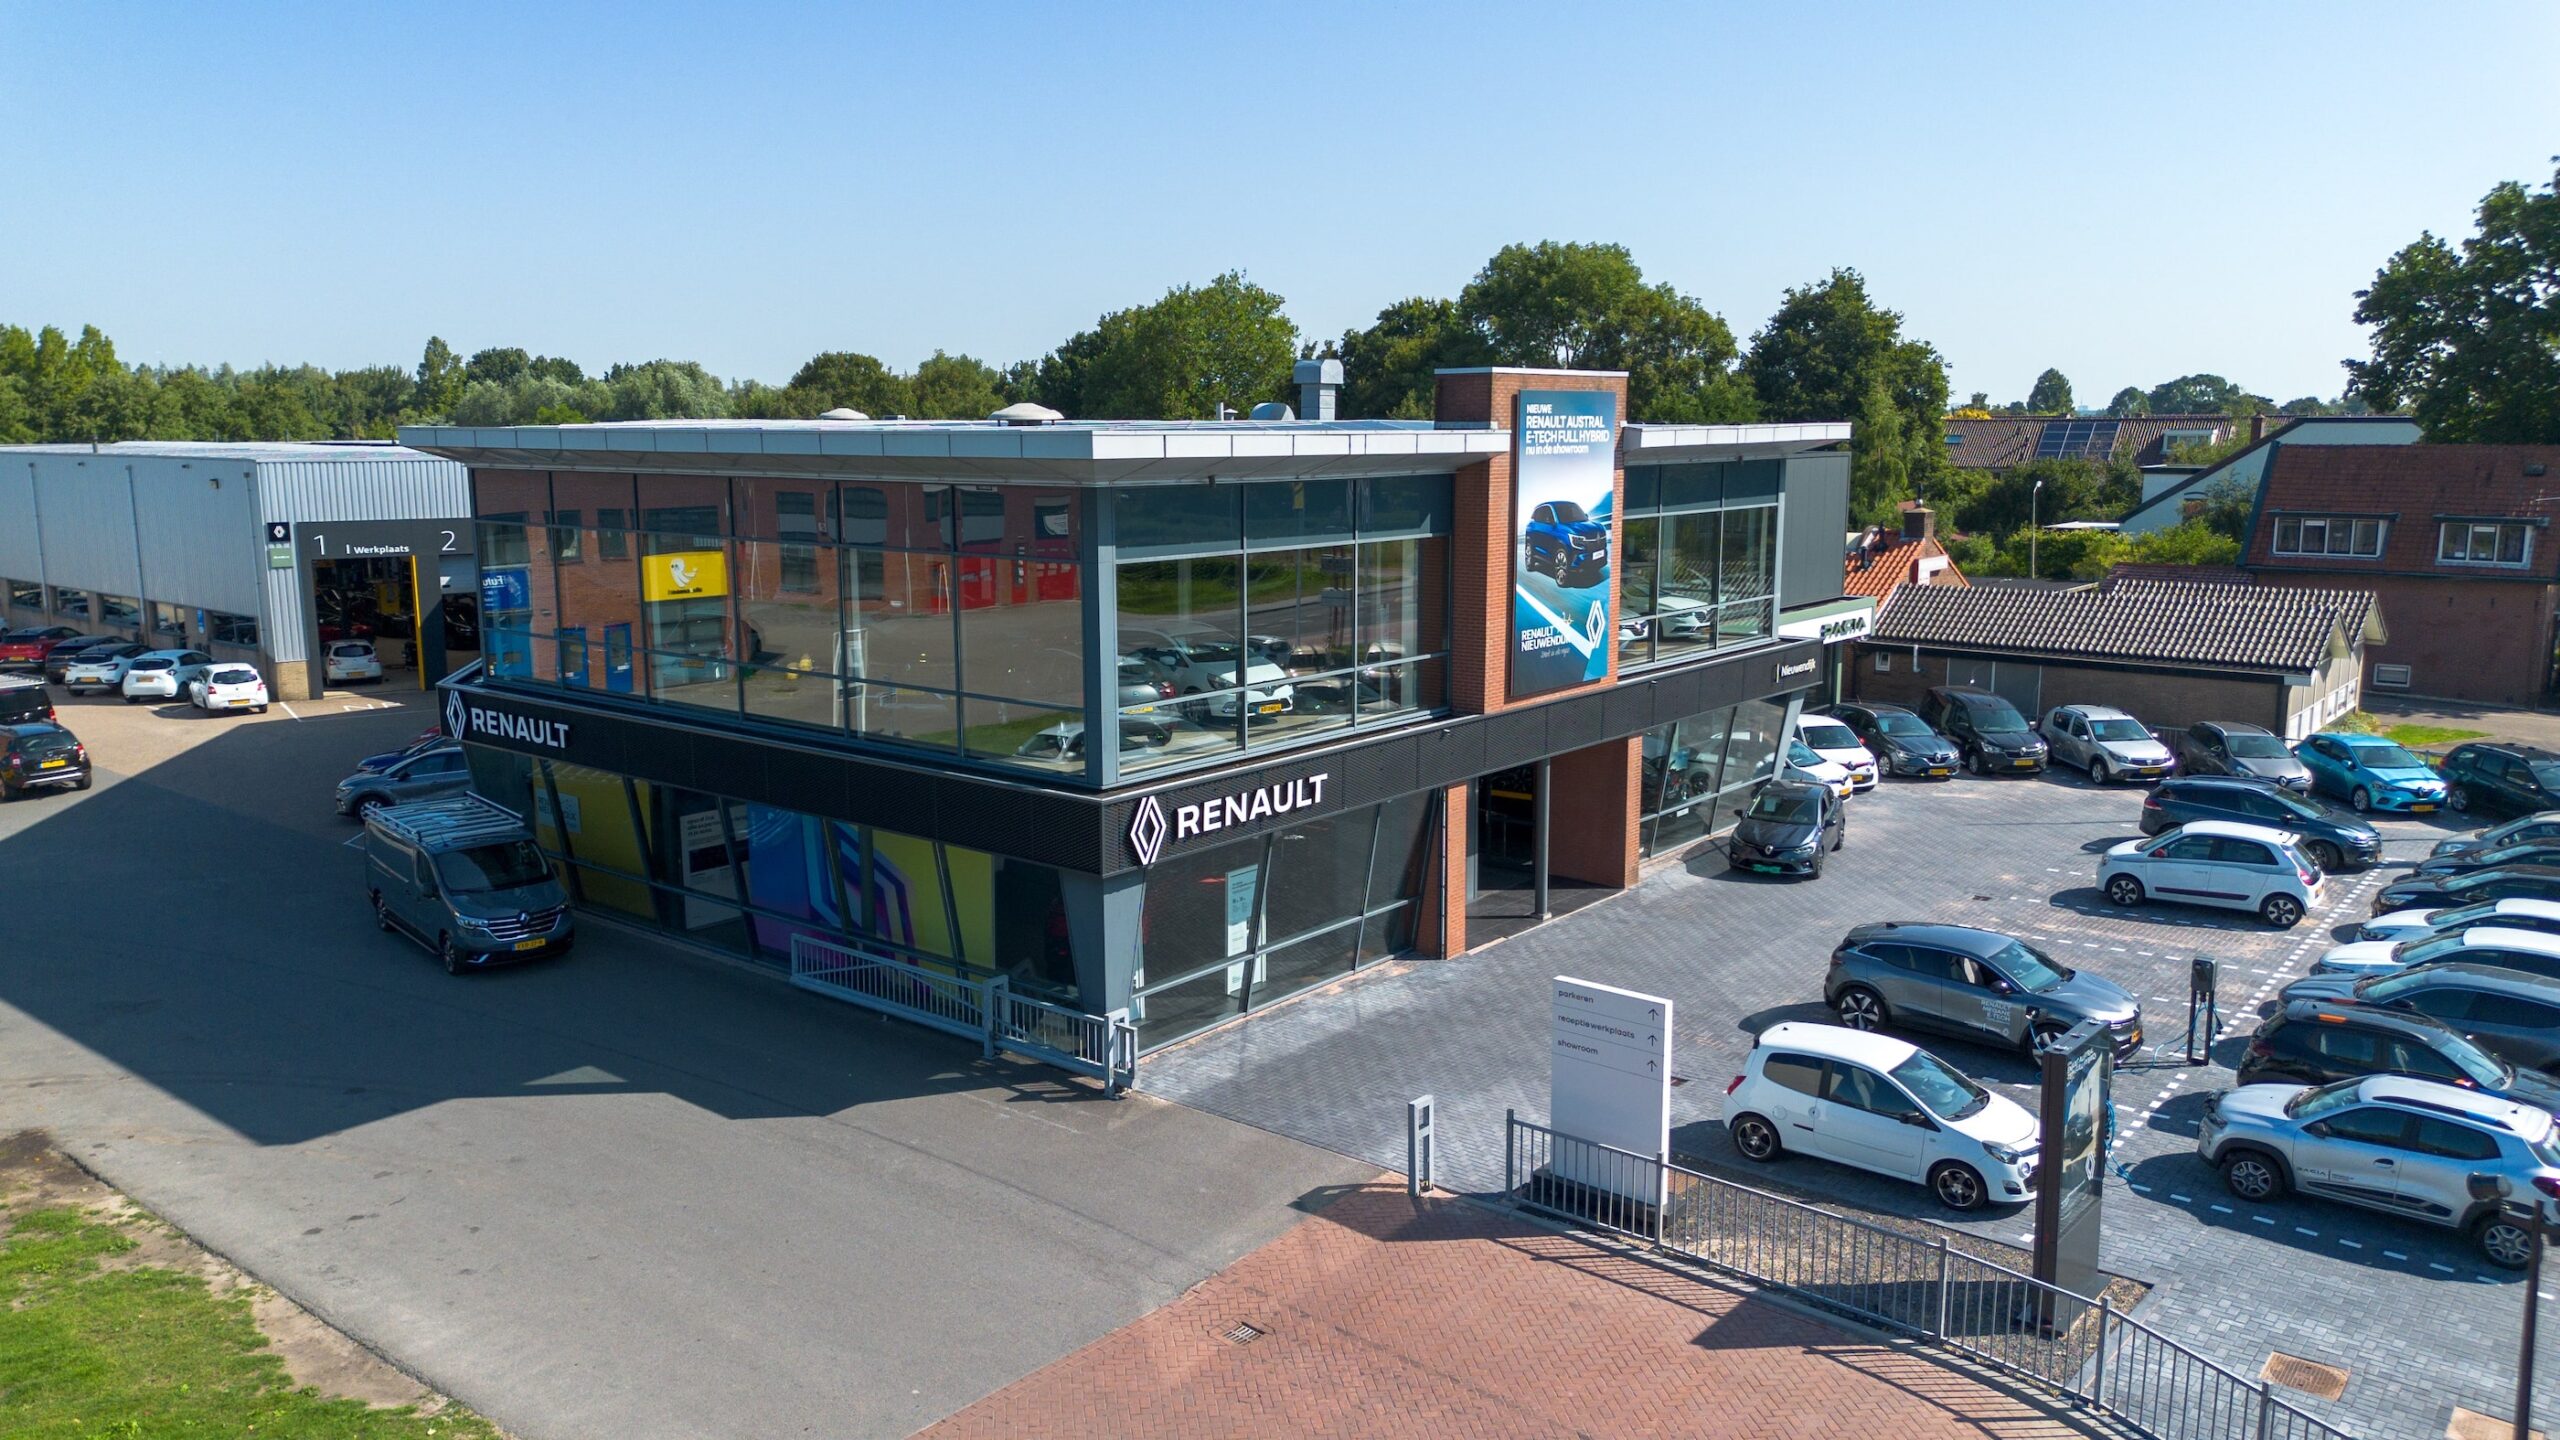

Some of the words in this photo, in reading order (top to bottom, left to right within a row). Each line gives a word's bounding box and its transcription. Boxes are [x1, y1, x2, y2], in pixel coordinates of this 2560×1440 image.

[1526, 404, 1552, 413] NIEUWE
[1526, 416, 1566, 428] RENAULT
[1567, 416, 1605, 428] AUSTRAL
[1526, 430, 1557, 443] E-TECH
[1558, 430, 1578, 442] FULL
[1579, 430, 1609, 442] HYBRID
[1526, 446, 1535, 455] nu
[1536, 444, 1542, 454] in
[1543, 444, 1552, 454] de
[1553, 444, 1589, 454] showroom
[313, 535, 326, 555] 1
[440, 530, 456, 551] 2
[353, 544, 409, 555] Werkplaats
[1521, 626, 1553, 640] RENAULT
[470, 707, 569, 748] RENAULT
[1177, 773, 1328, 839] RENAULT
[1558, 990, 1594, 1004] parkeren
[1557, 1039, 1598, 1055] showroom
